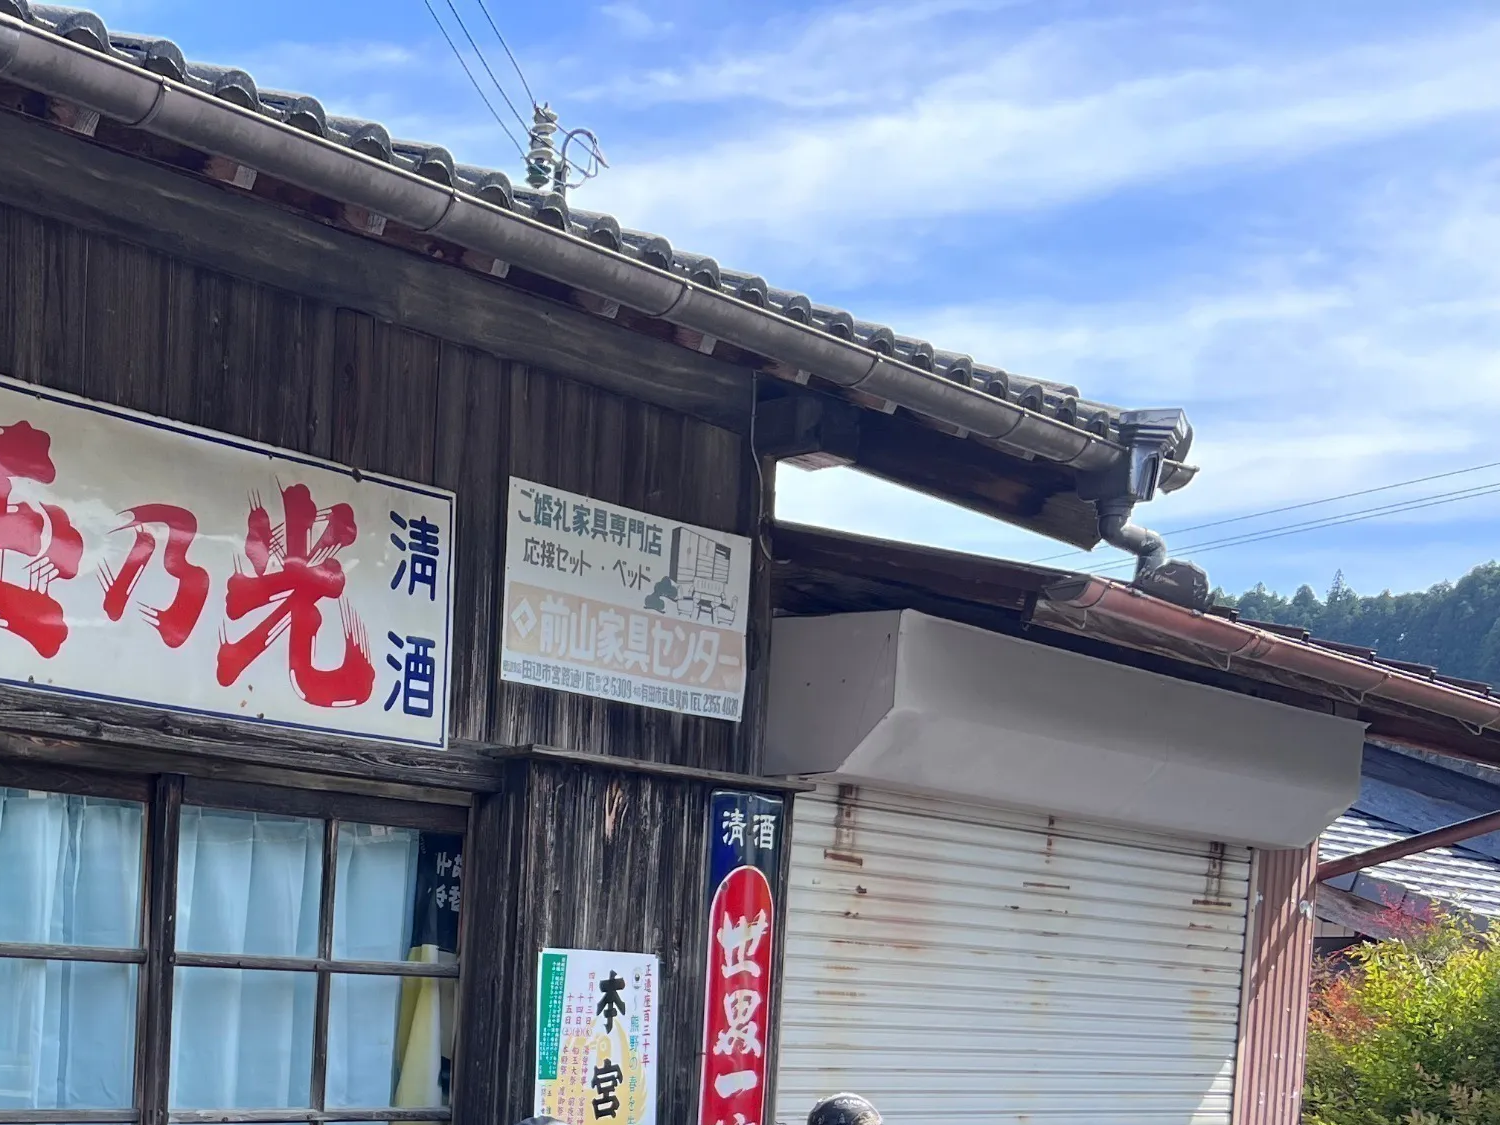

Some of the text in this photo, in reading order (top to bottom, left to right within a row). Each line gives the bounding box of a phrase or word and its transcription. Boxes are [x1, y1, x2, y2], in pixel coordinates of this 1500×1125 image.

[518, 488, 663, 557] ご婚礼家具専門店
[384, 510, 440, 718] 清酒
[539, 593, 741, 684] 前山家具センター
[722, 808, 776, 850] 清酒
